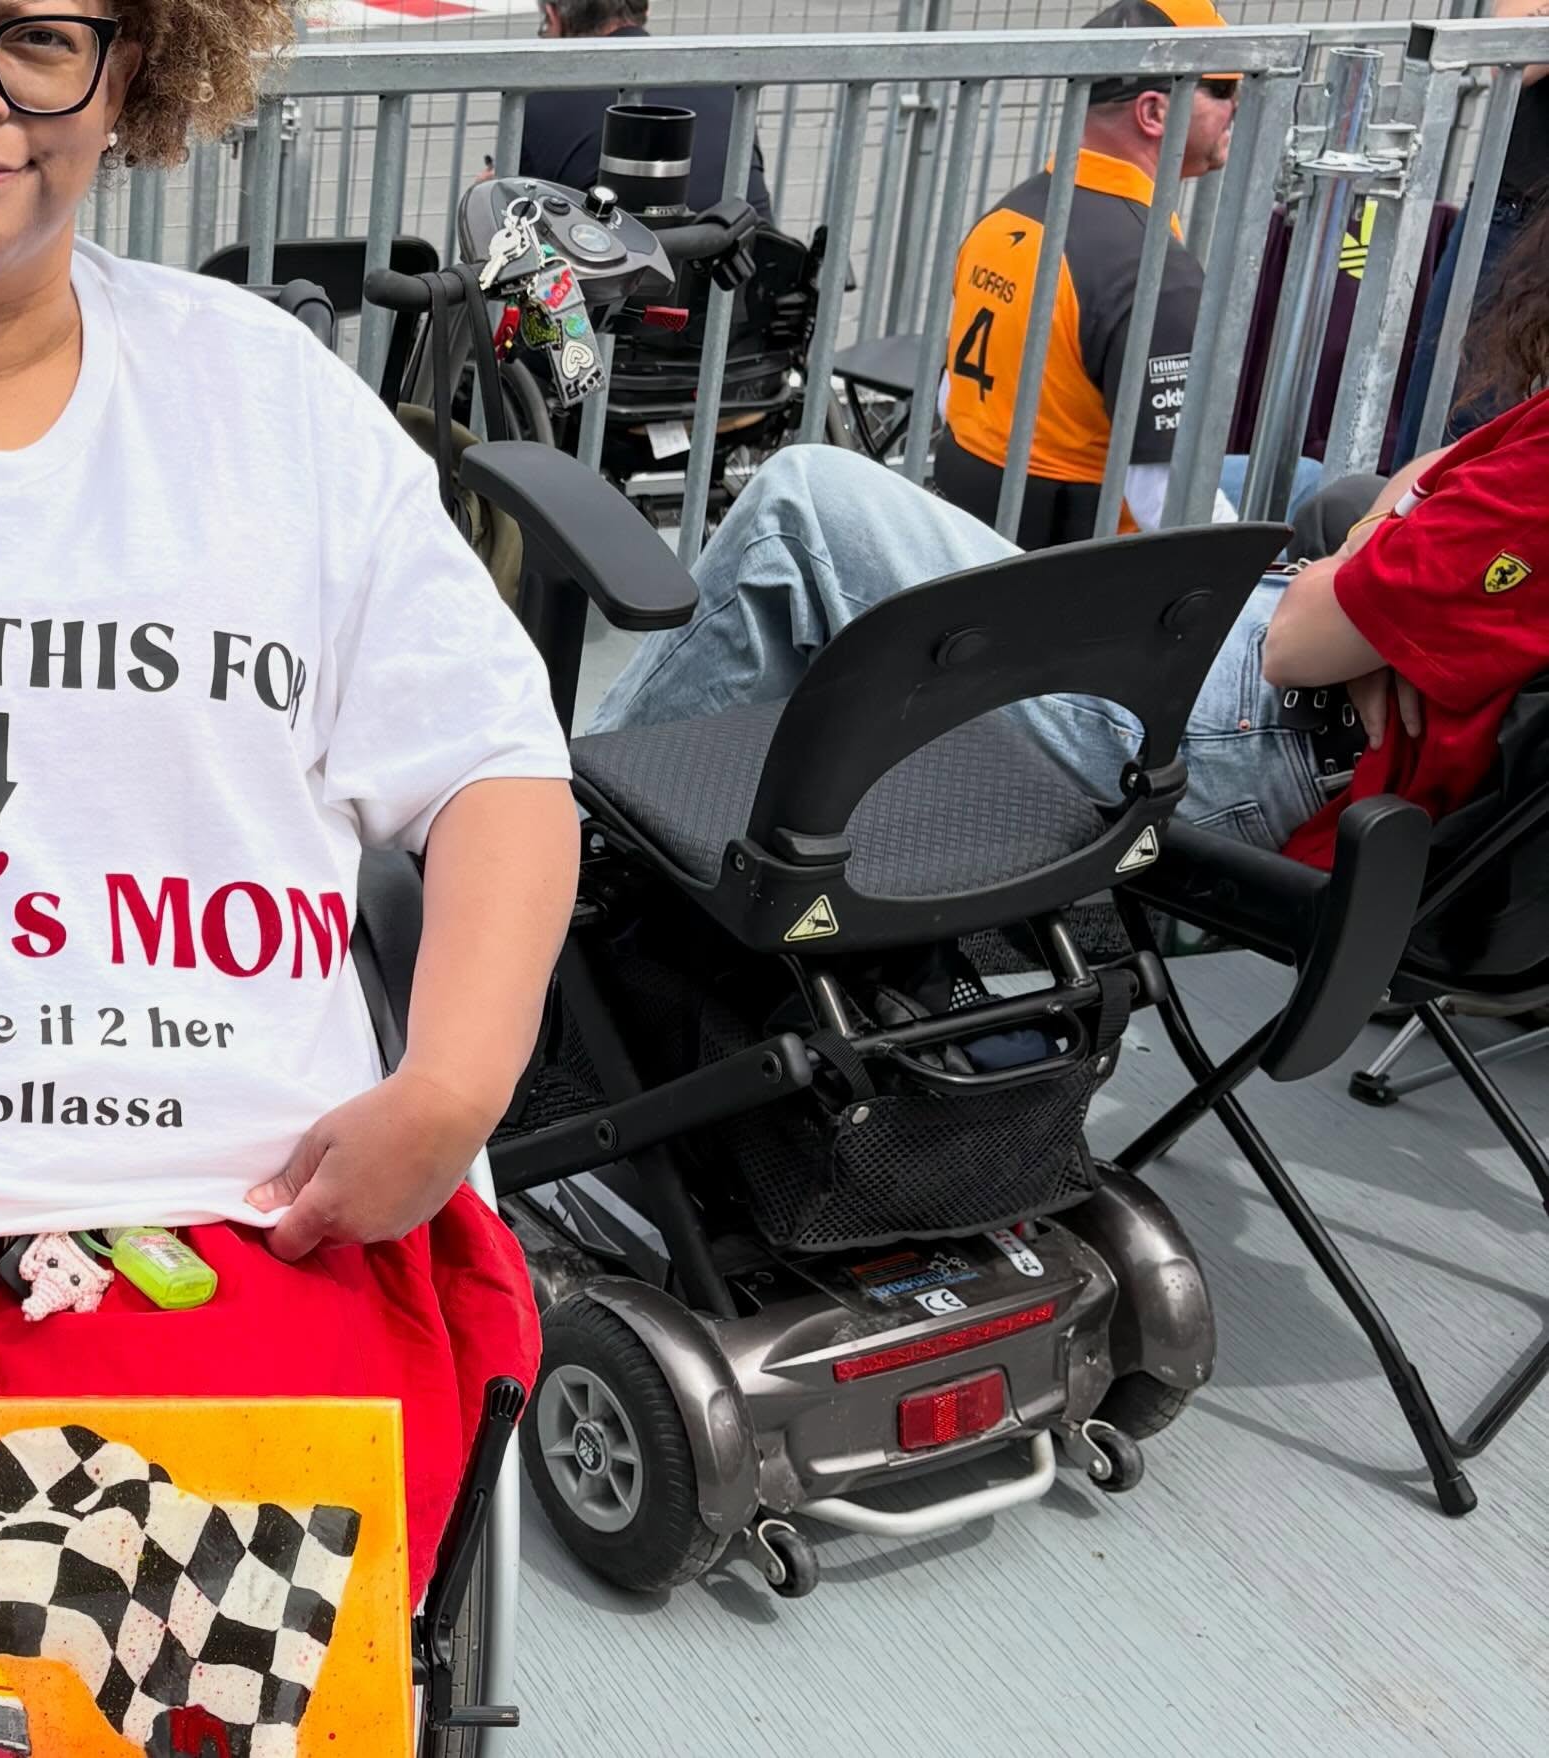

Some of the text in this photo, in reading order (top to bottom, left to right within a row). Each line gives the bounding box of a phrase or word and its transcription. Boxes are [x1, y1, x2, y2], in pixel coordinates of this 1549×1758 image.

[953, 306, 995, 403] 4
[210, 631, 306, 729] FOR
[105, 873, 349, 979] MOM
[41, 1005, 73, 1044] it
[99, 1008, 126, 1046] 2
[149, 1008, 233, 1047] her
